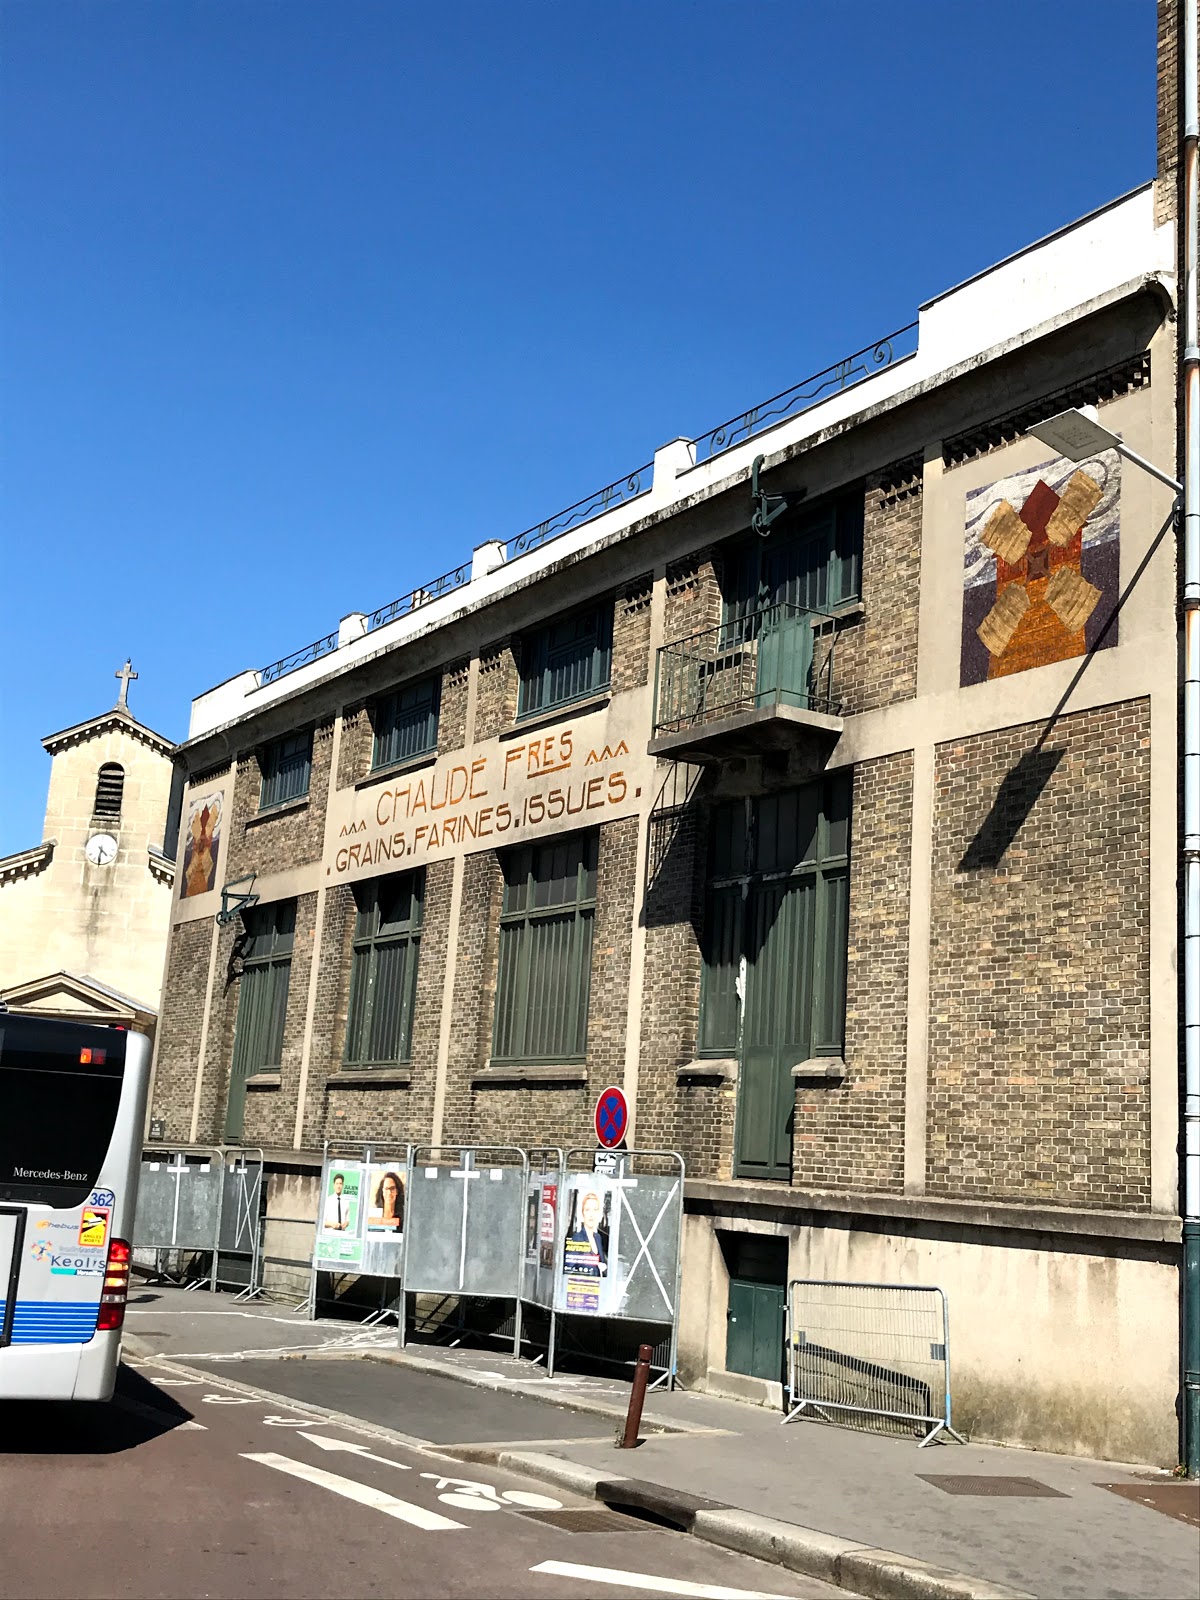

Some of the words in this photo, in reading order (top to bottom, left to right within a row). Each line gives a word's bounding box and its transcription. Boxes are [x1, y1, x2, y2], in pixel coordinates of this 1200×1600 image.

[503, 729, 573, 791] FRES
[13, 1166, 88, 1181] Mercedes-Benz
[90, 1192, 114, 1207] 362
[51, 1255, 106, 1269] Keolis
